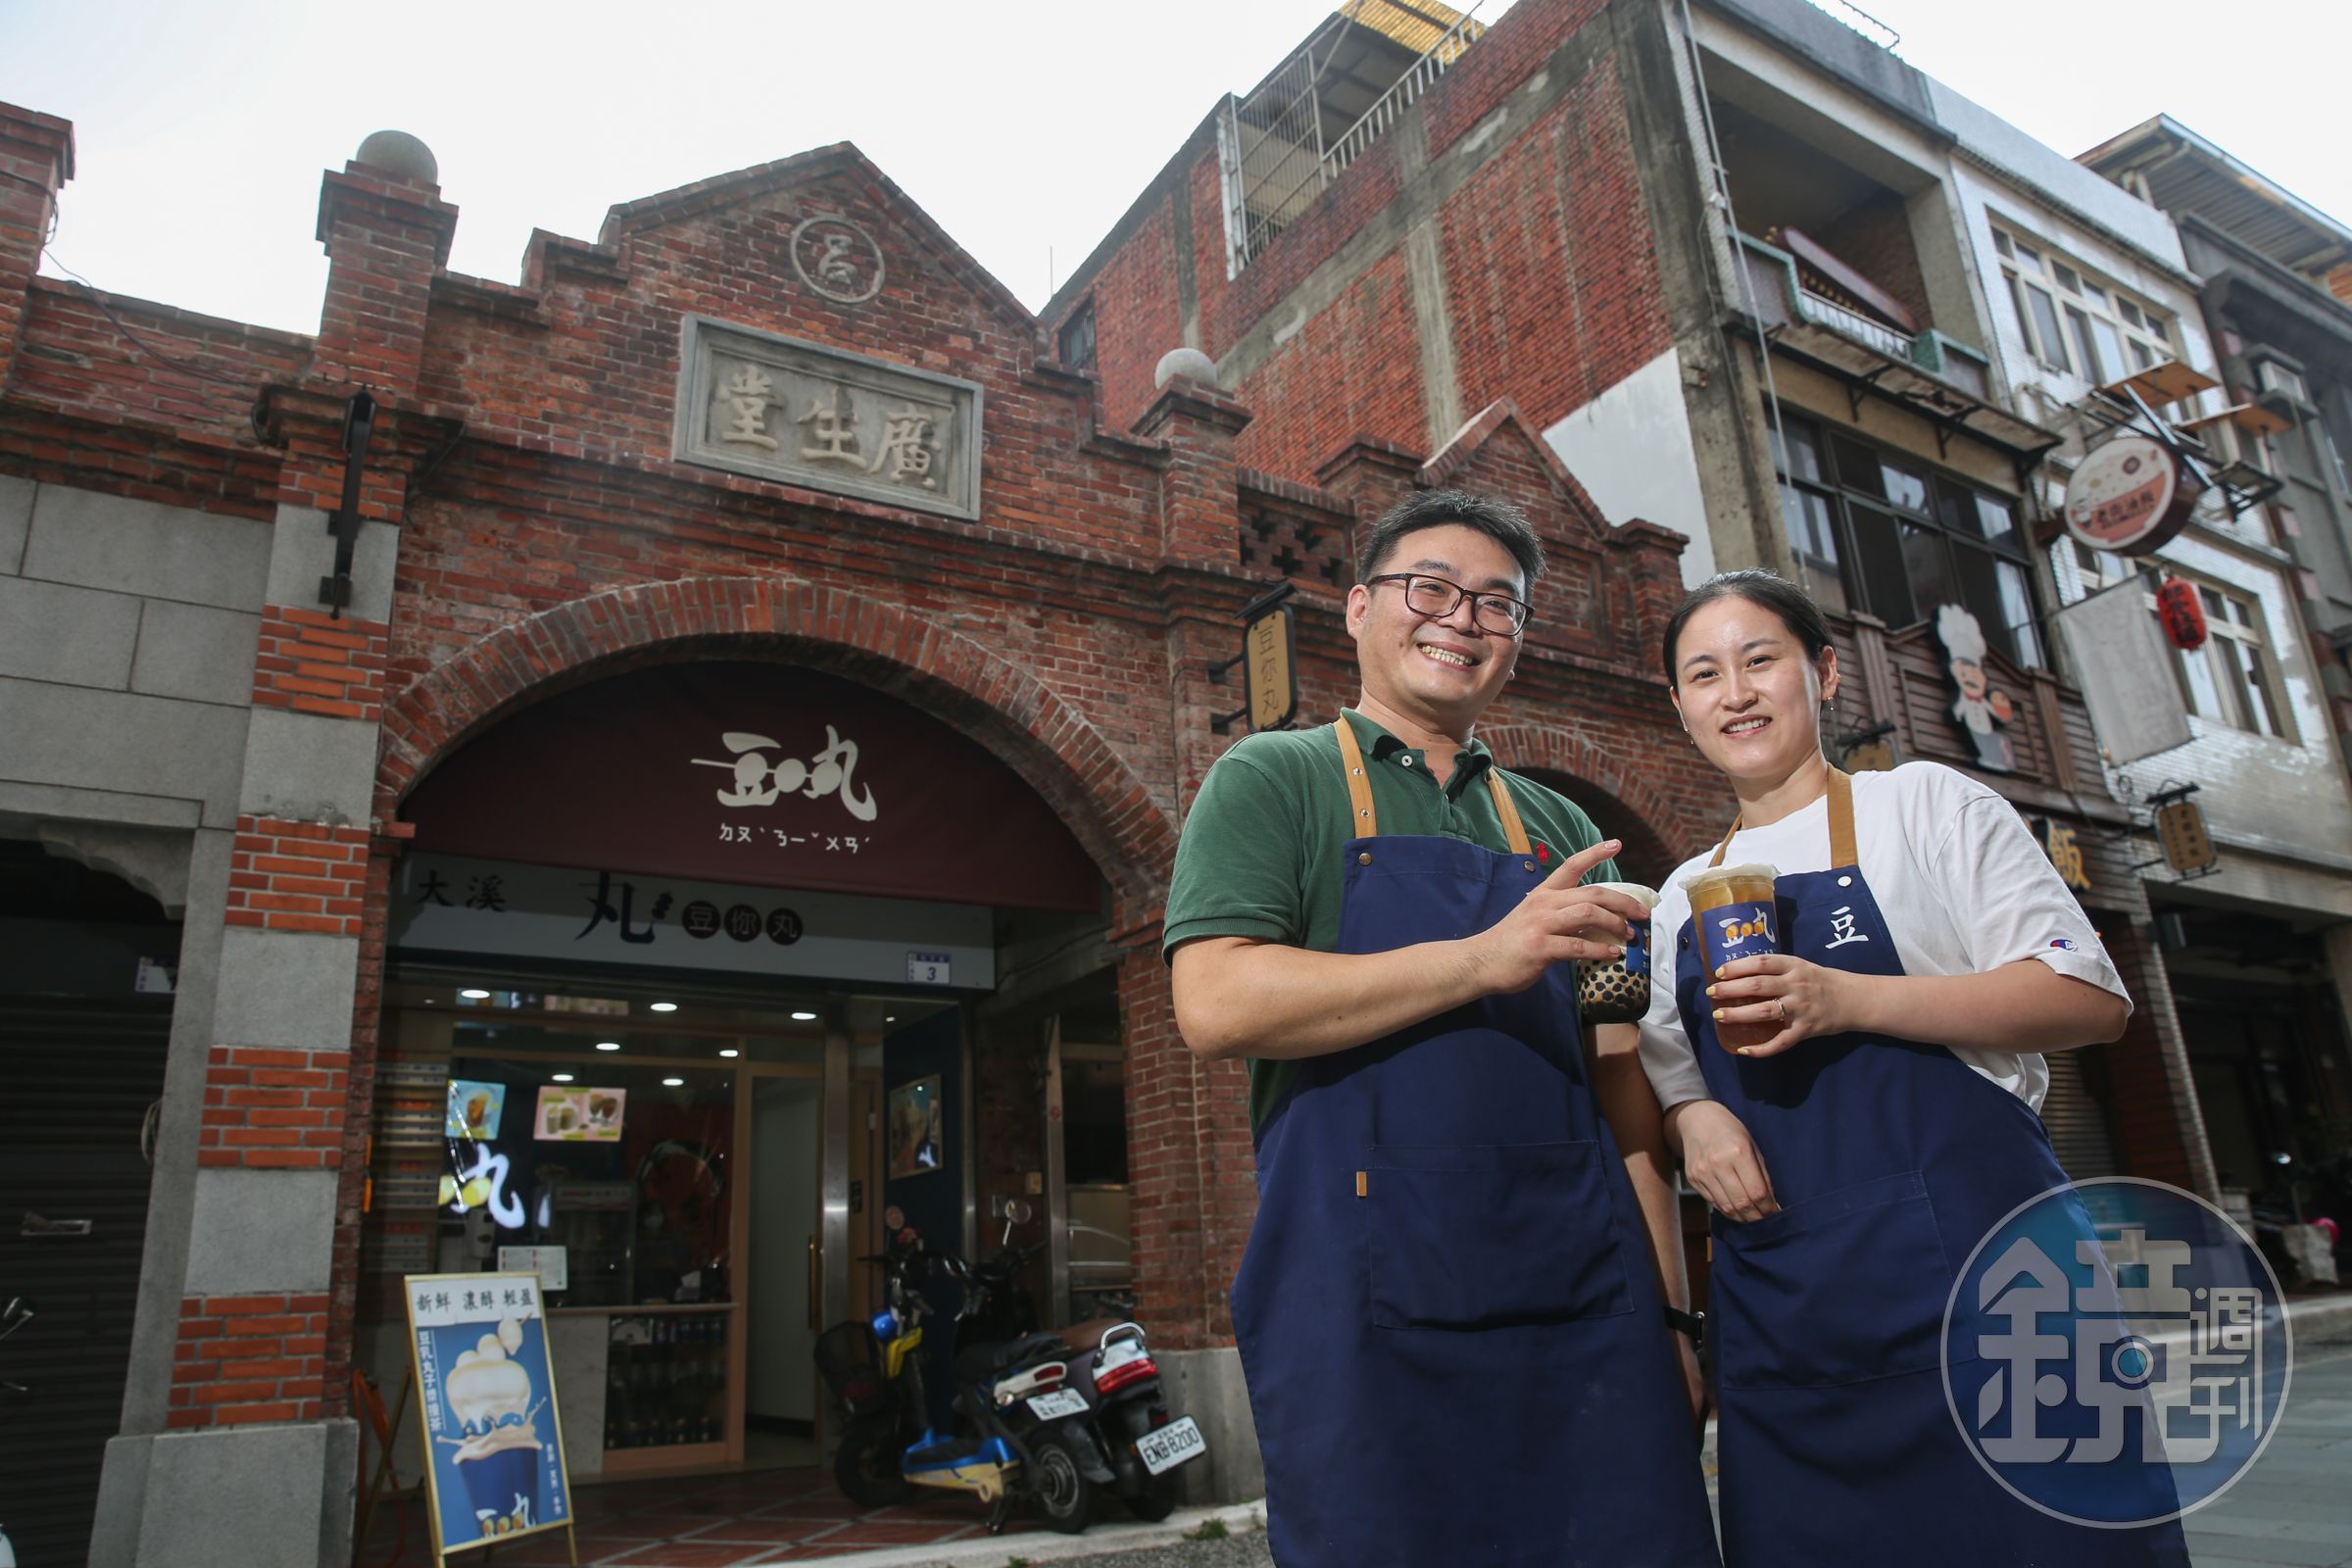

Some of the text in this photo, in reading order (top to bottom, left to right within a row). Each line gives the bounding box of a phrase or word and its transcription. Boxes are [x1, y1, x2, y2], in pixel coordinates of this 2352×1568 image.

[416, 870, 506, 912] 大溪
[1825, 906, 1869, 949] 豆
[926, 966, 937, 981] 3
[416, 1292, 451, 1313] 新鮮
